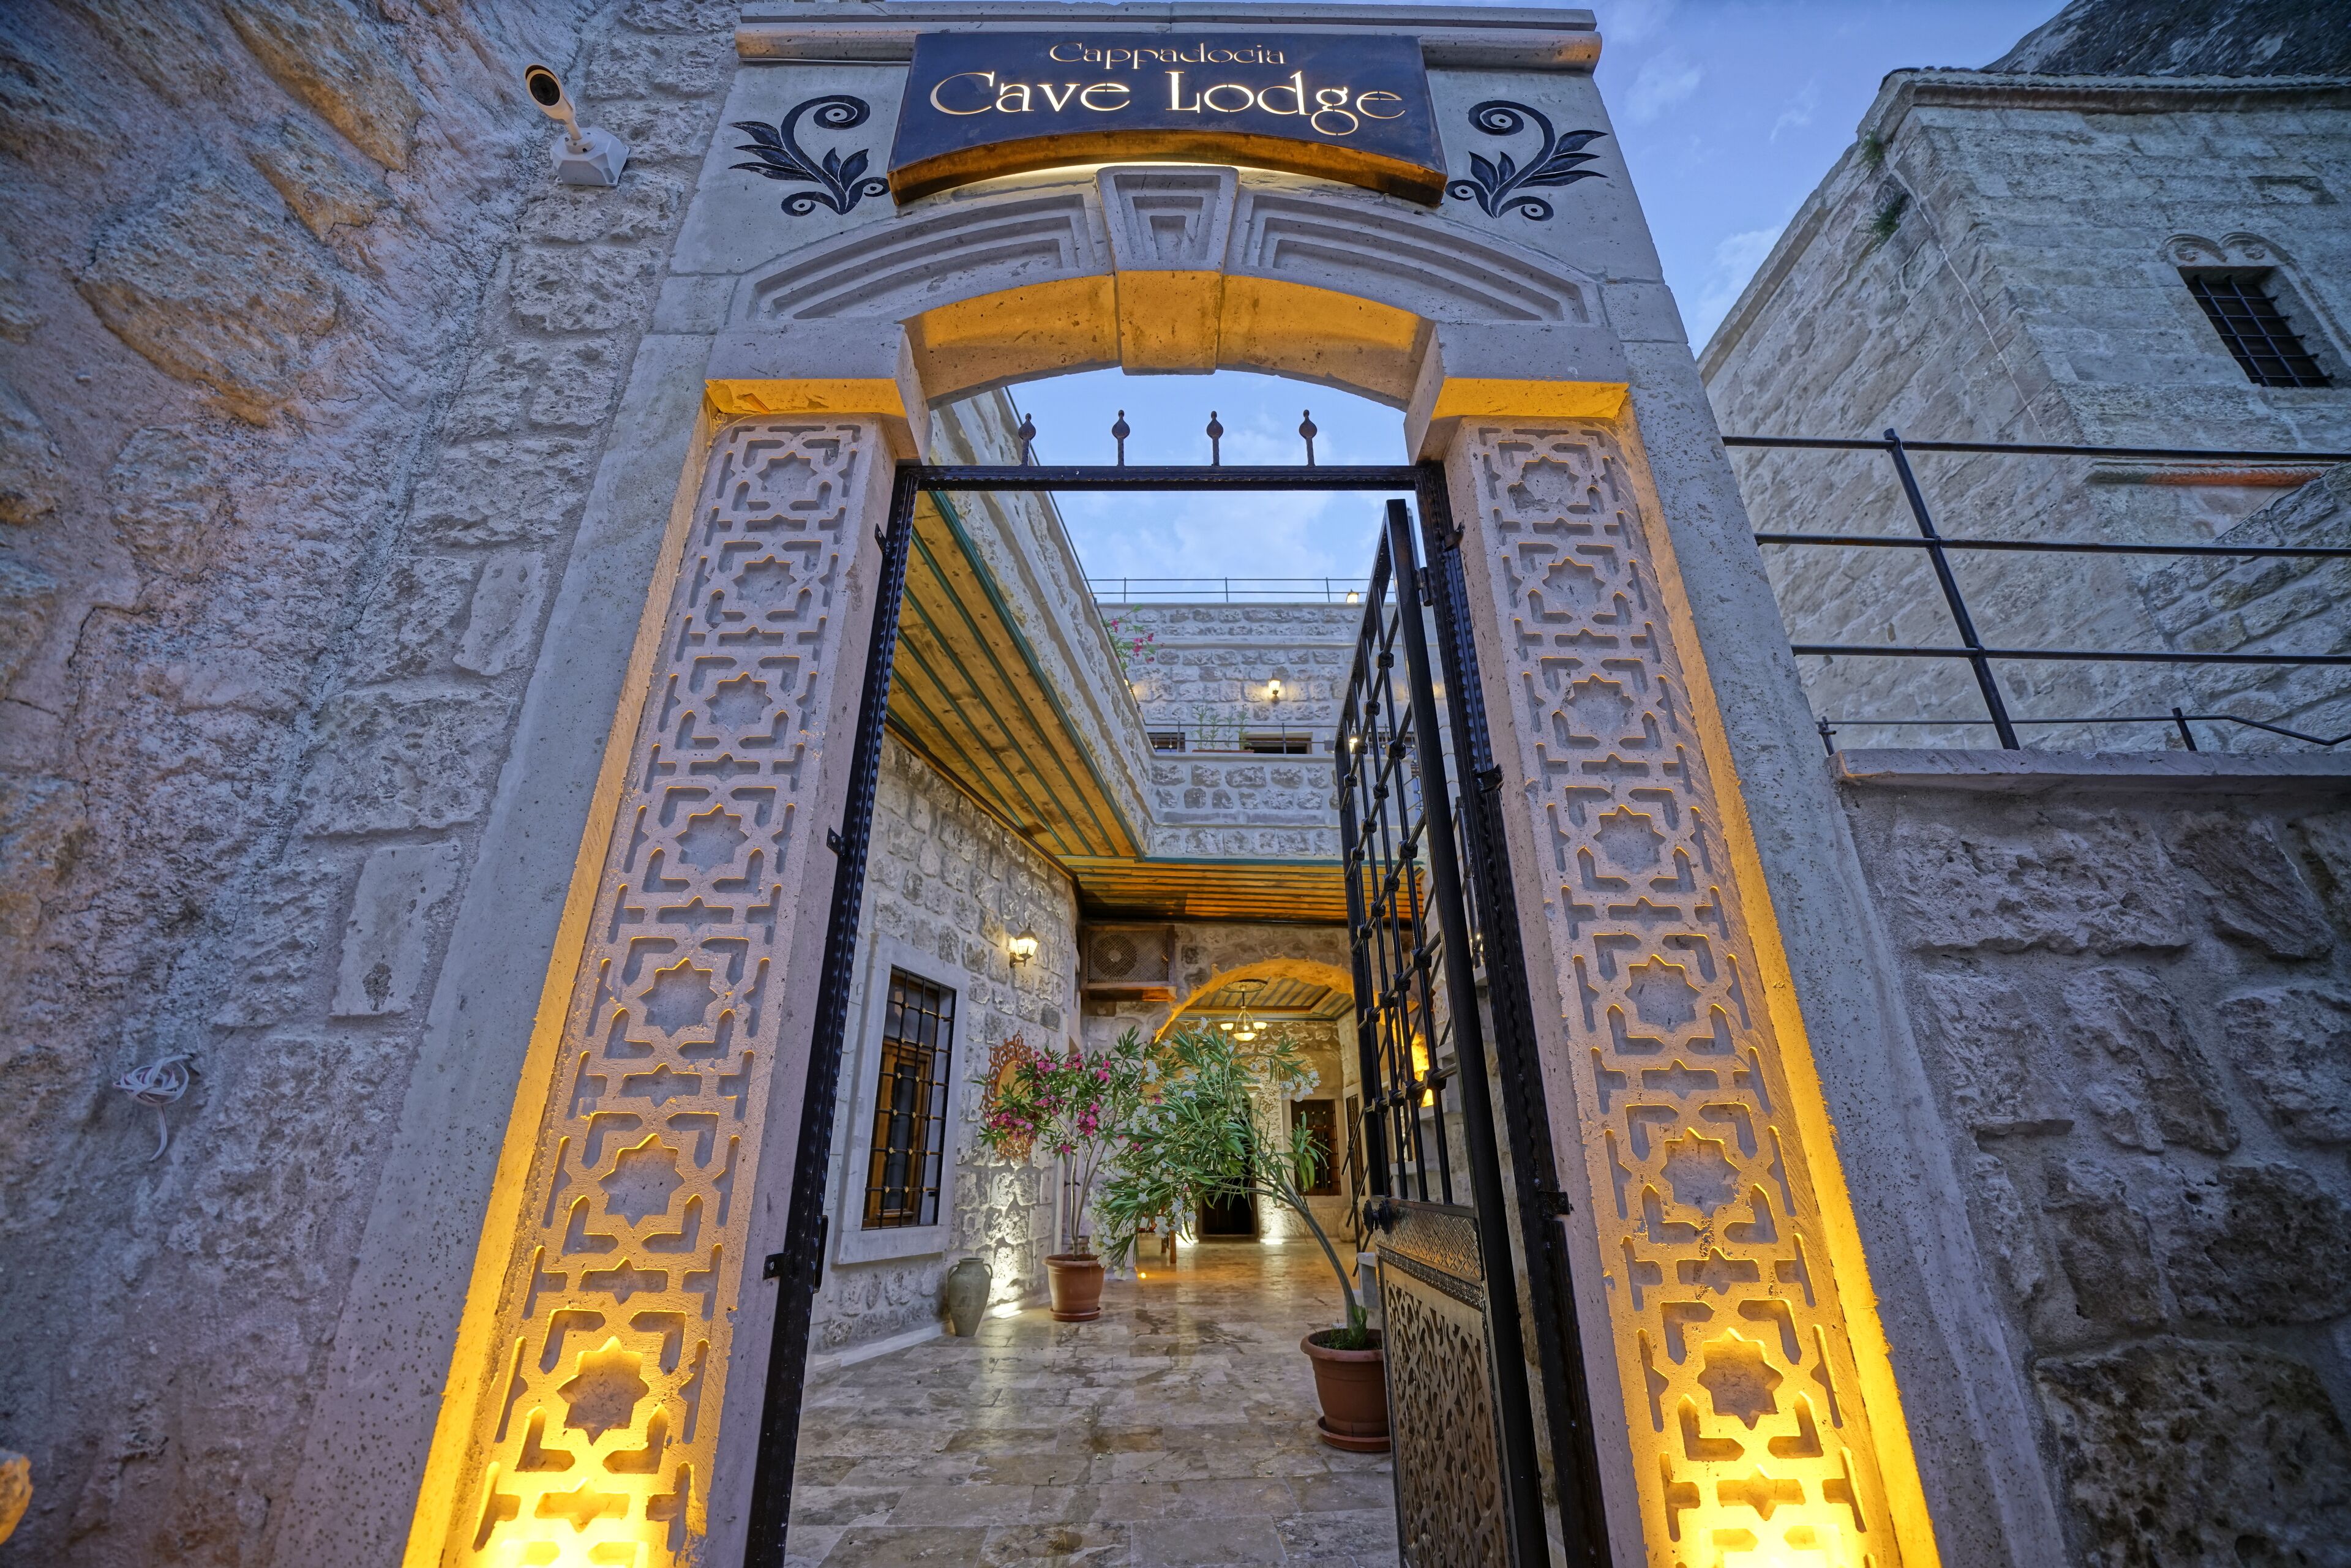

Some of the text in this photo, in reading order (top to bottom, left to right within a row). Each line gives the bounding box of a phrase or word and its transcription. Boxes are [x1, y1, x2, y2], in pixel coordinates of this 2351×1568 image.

[1049, 42, 1286, 69] Cappadocia
[929, 70, 1406, 136] Cave Lodge
